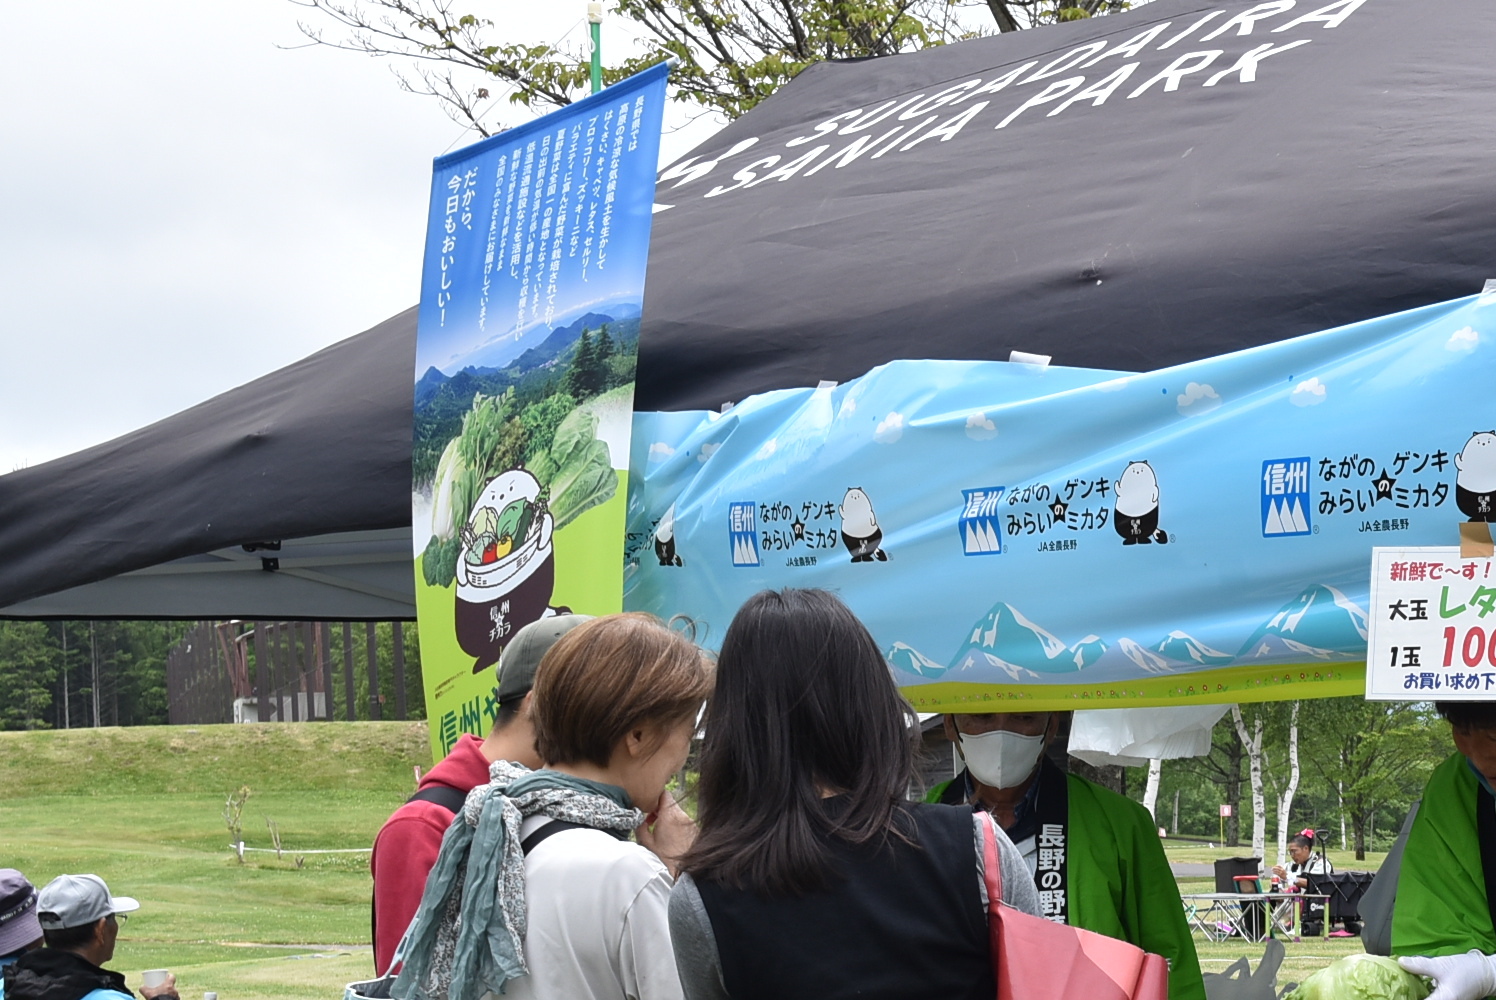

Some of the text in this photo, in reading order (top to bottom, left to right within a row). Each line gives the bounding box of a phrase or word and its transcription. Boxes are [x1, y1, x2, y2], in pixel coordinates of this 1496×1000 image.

[787, 0, 1364, 145] SUGADAIRA
[628, 95, 645, 152] 長野県では
[703, 39, 1312, 198] SANIA PARK
[461, 166, 478, 231] だから、
[1263, 461, 1307, 495] 信州
[1318, 449, 1449, 482] ながの ゲンキ
[963, 490, 1002, 518] 信州
[1005, 476, 1111, 505] ながの ゲンキ
[1318, 488, 1376, 515] みらい
[1394, 481, 1450, 509] ミカタ
[730, 505, 755, 533] 信州
[759, 501, 836, 523] ながの ゲンキ
[1006, 512, 1052, 536] みらい
[1066, 506, 1109, 531] ミカタ
[1358, 518, 1410, 533] JA全農長野
[761, 530, 795, 551] みらい
[804, 528, 838, 550] ミカタ
[1037, 539, 1078, 552] JA全農長野
[785, 556, 817, 567] JA全農長野
[1388, 599, 1428, 621] 大玉
[1390, 646, 1421, 667] 1玉
